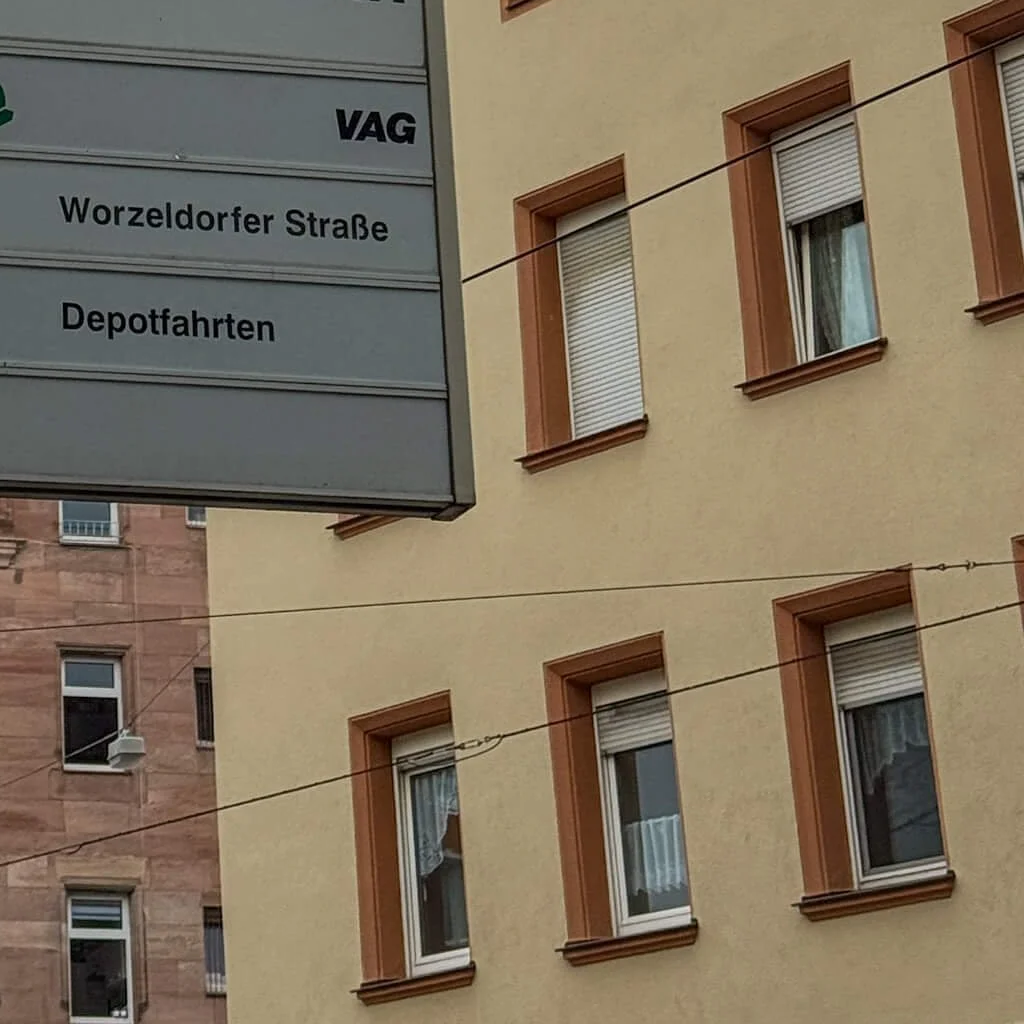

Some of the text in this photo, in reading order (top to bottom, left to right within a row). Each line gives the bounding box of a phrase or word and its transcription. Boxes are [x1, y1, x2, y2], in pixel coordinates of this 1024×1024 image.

[335, 109, 416, 144] VAG
[59, 195, 274, 235] Worzeldorfer
[286, 208, 389, 242] Straße
[62, 302, 275, 342] Depotfahrten
